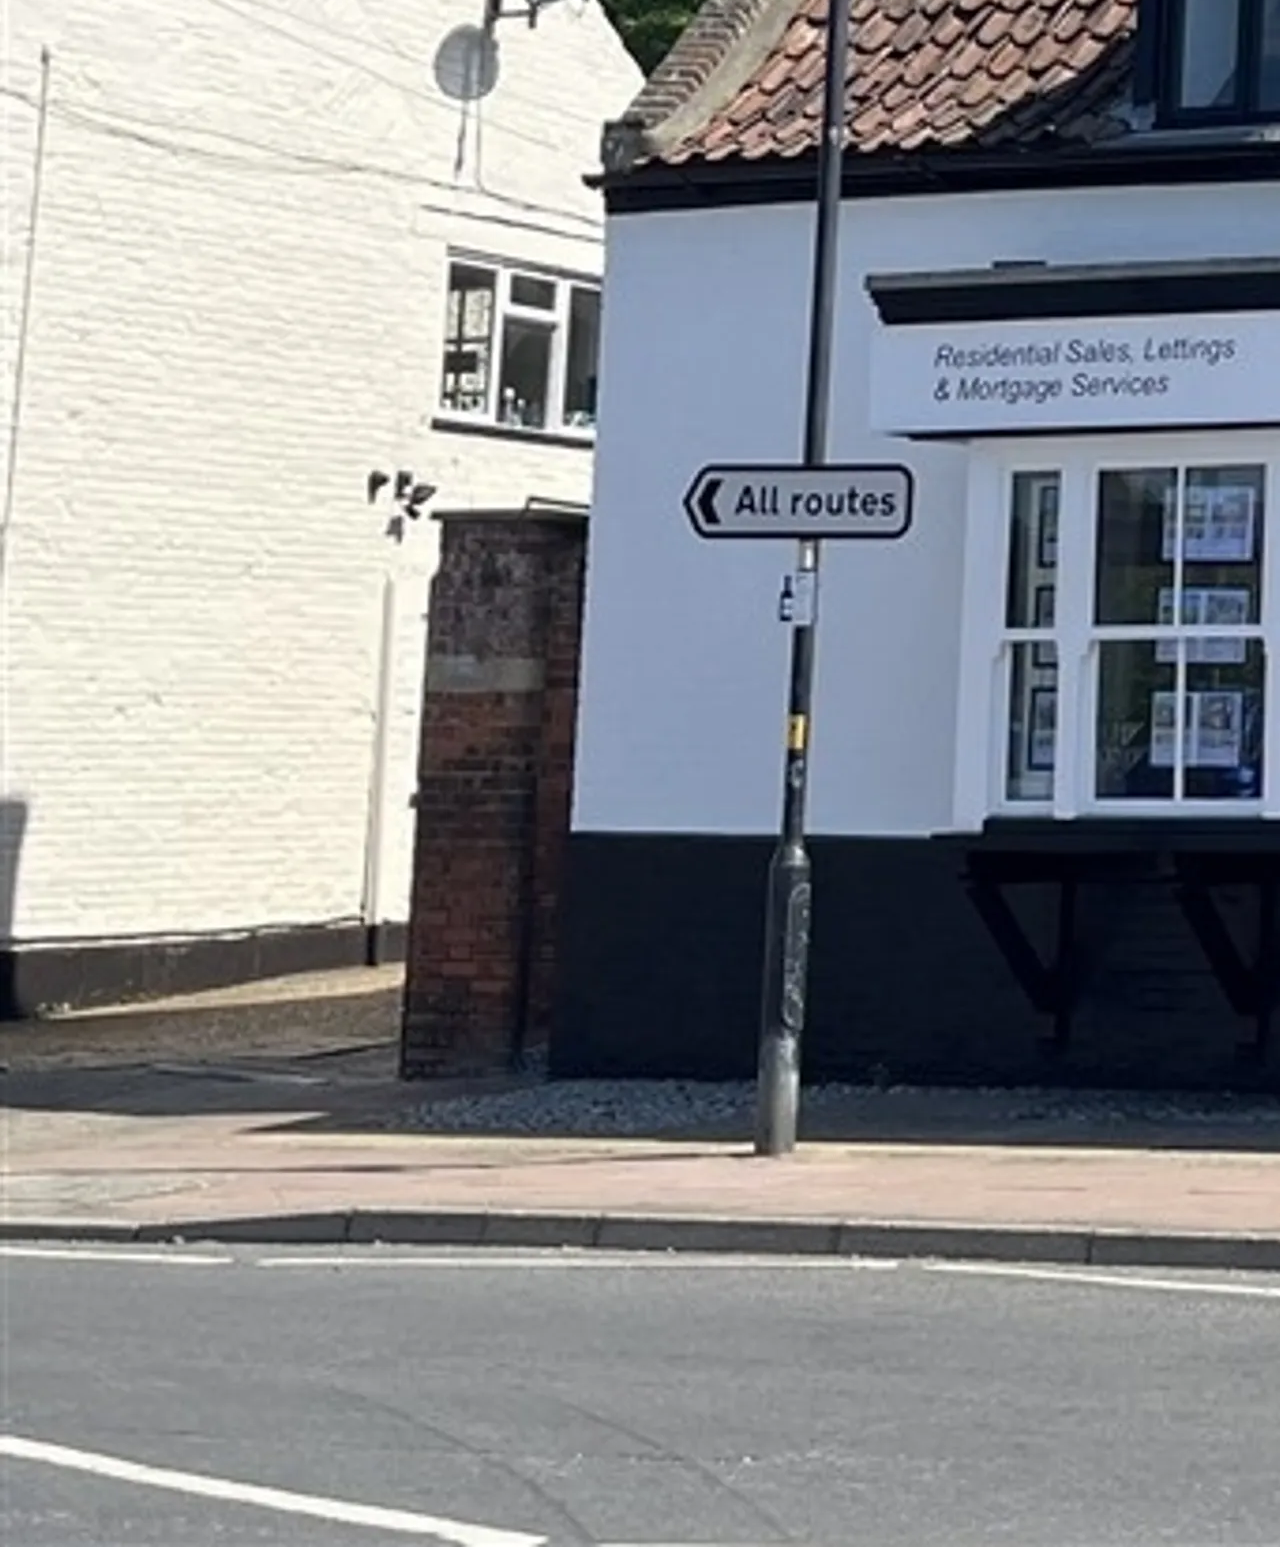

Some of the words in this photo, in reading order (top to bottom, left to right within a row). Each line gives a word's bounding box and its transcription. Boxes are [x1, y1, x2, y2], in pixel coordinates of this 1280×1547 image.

[933, 341, 1062, 368] Residential
[1064, 338, 1135, 365] Sales,
[1143, 336, 1237, 365] Lettings
[933, 376, 950, 402] &
[956, 375, 1064, 404] Mortgage
[1070, 370, 1171, 398] Services
[734, 484, 779, 516] All
[790, 485, 897, 517] routes
